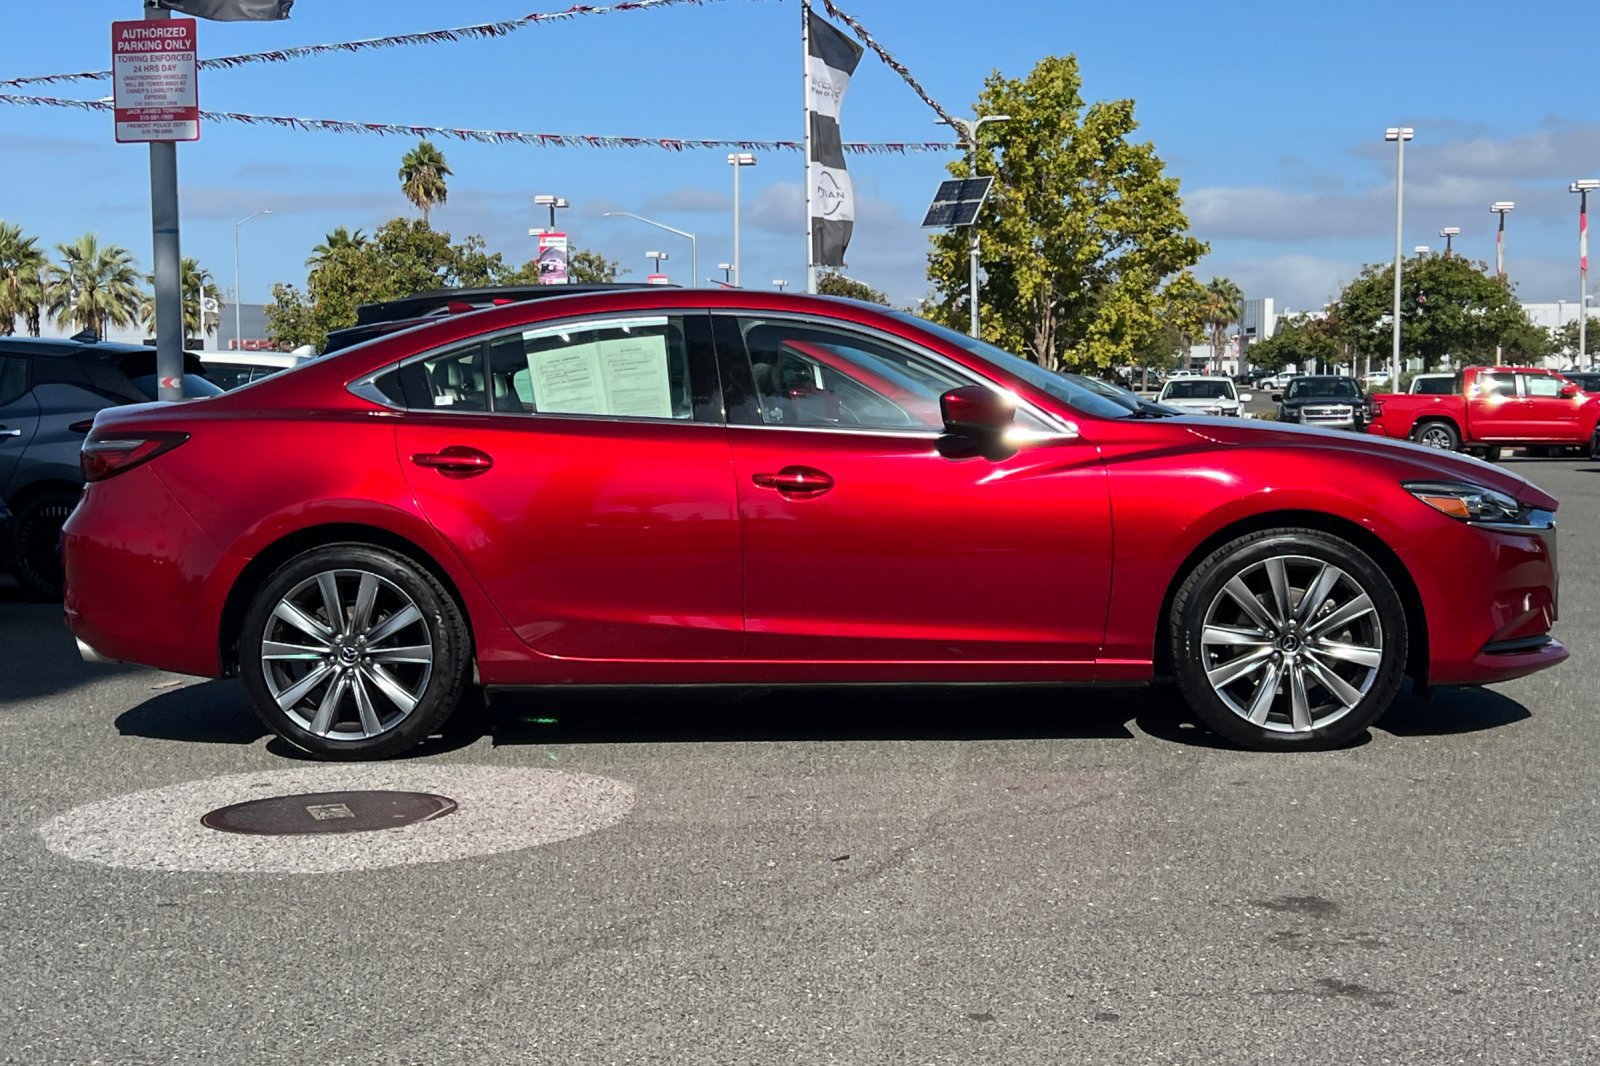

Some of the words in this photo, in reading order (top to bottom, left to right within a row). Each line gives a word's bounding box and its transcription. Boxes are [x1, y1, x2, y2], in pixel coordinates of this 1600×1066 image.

[122, 27, 187, 39] AUTHORIZED
[117, 40, 162, 51] PARKING
[164, 39, 192, 50] ONLY
[117, 55, 148, 63] TOWING
[149, 53, 192, 62] ENFORCED
[133, 65, 142, 73] 24
[161, 64, 177, 72] DAY
